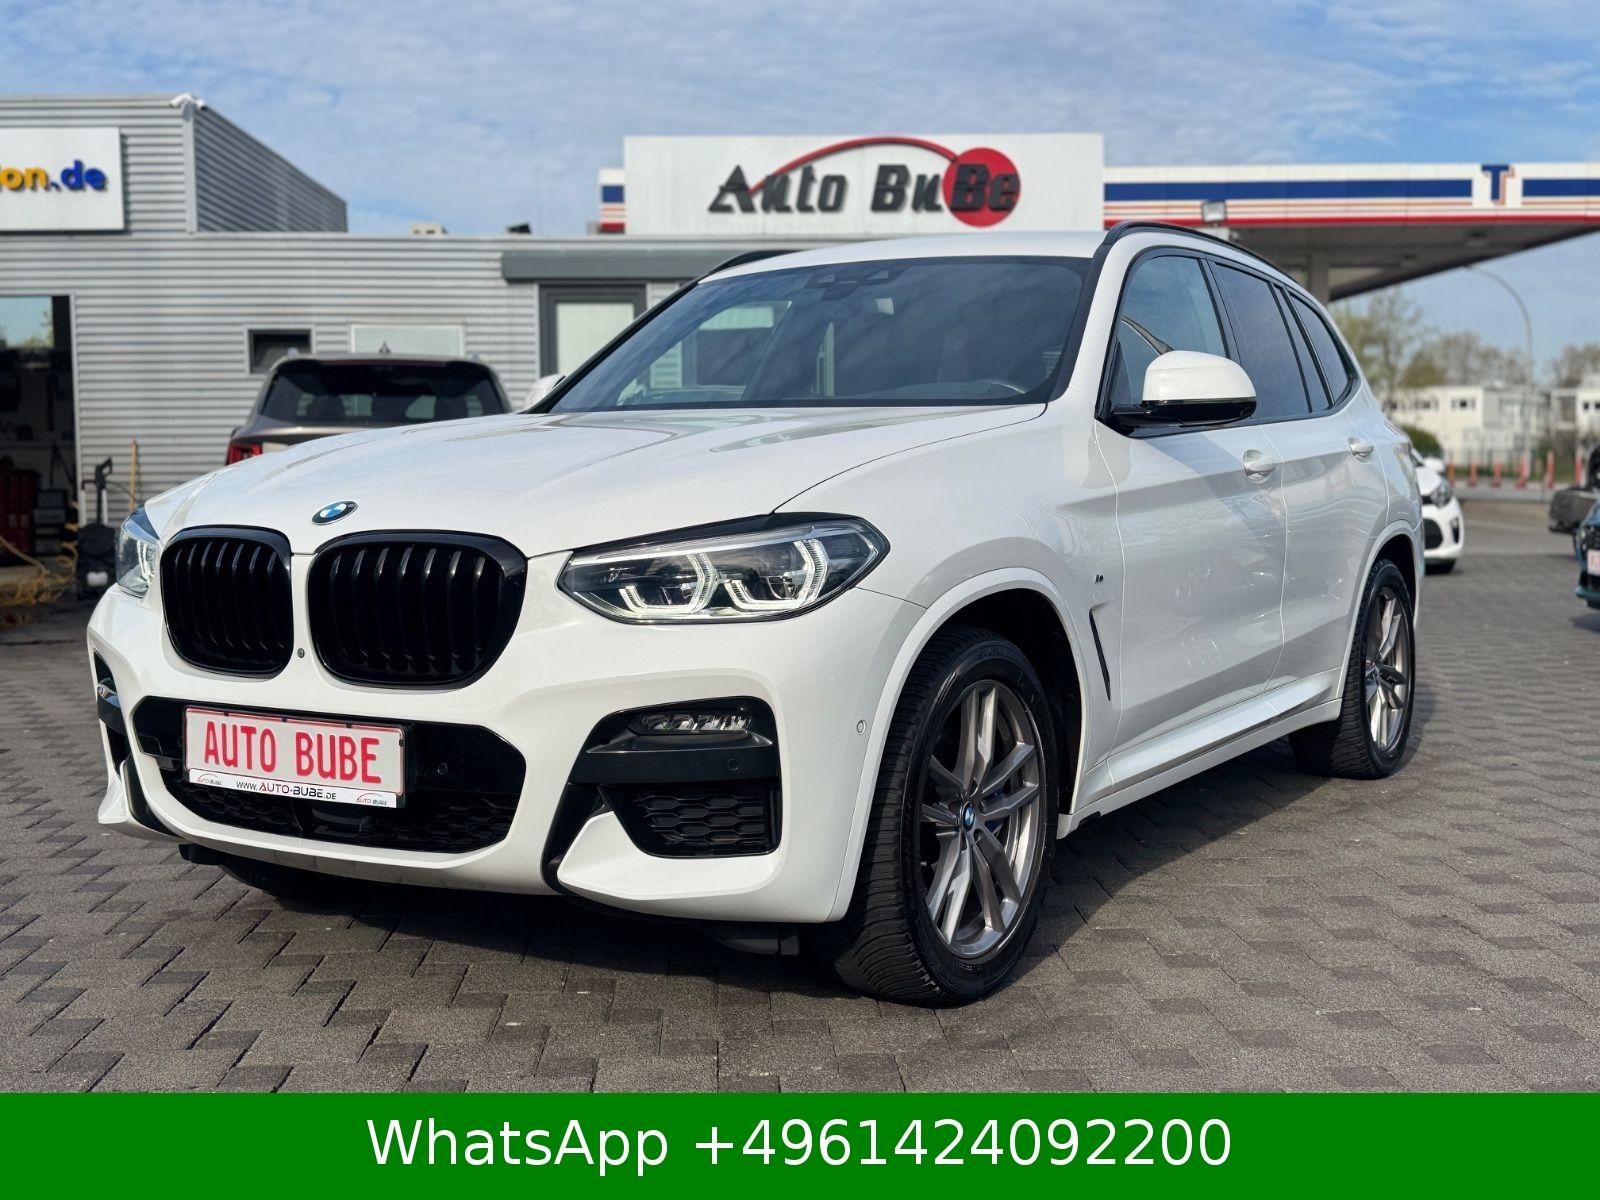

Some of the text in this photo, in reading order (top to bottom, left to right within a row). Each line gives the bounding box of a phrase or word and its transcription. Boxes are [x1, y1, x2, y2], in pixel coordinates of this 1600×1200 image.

[0, 159, 107, 191] on.de
[708, 164, 1021, 213] Auto BuBe
[205, 721, 381, 784] AUTO BUBE
